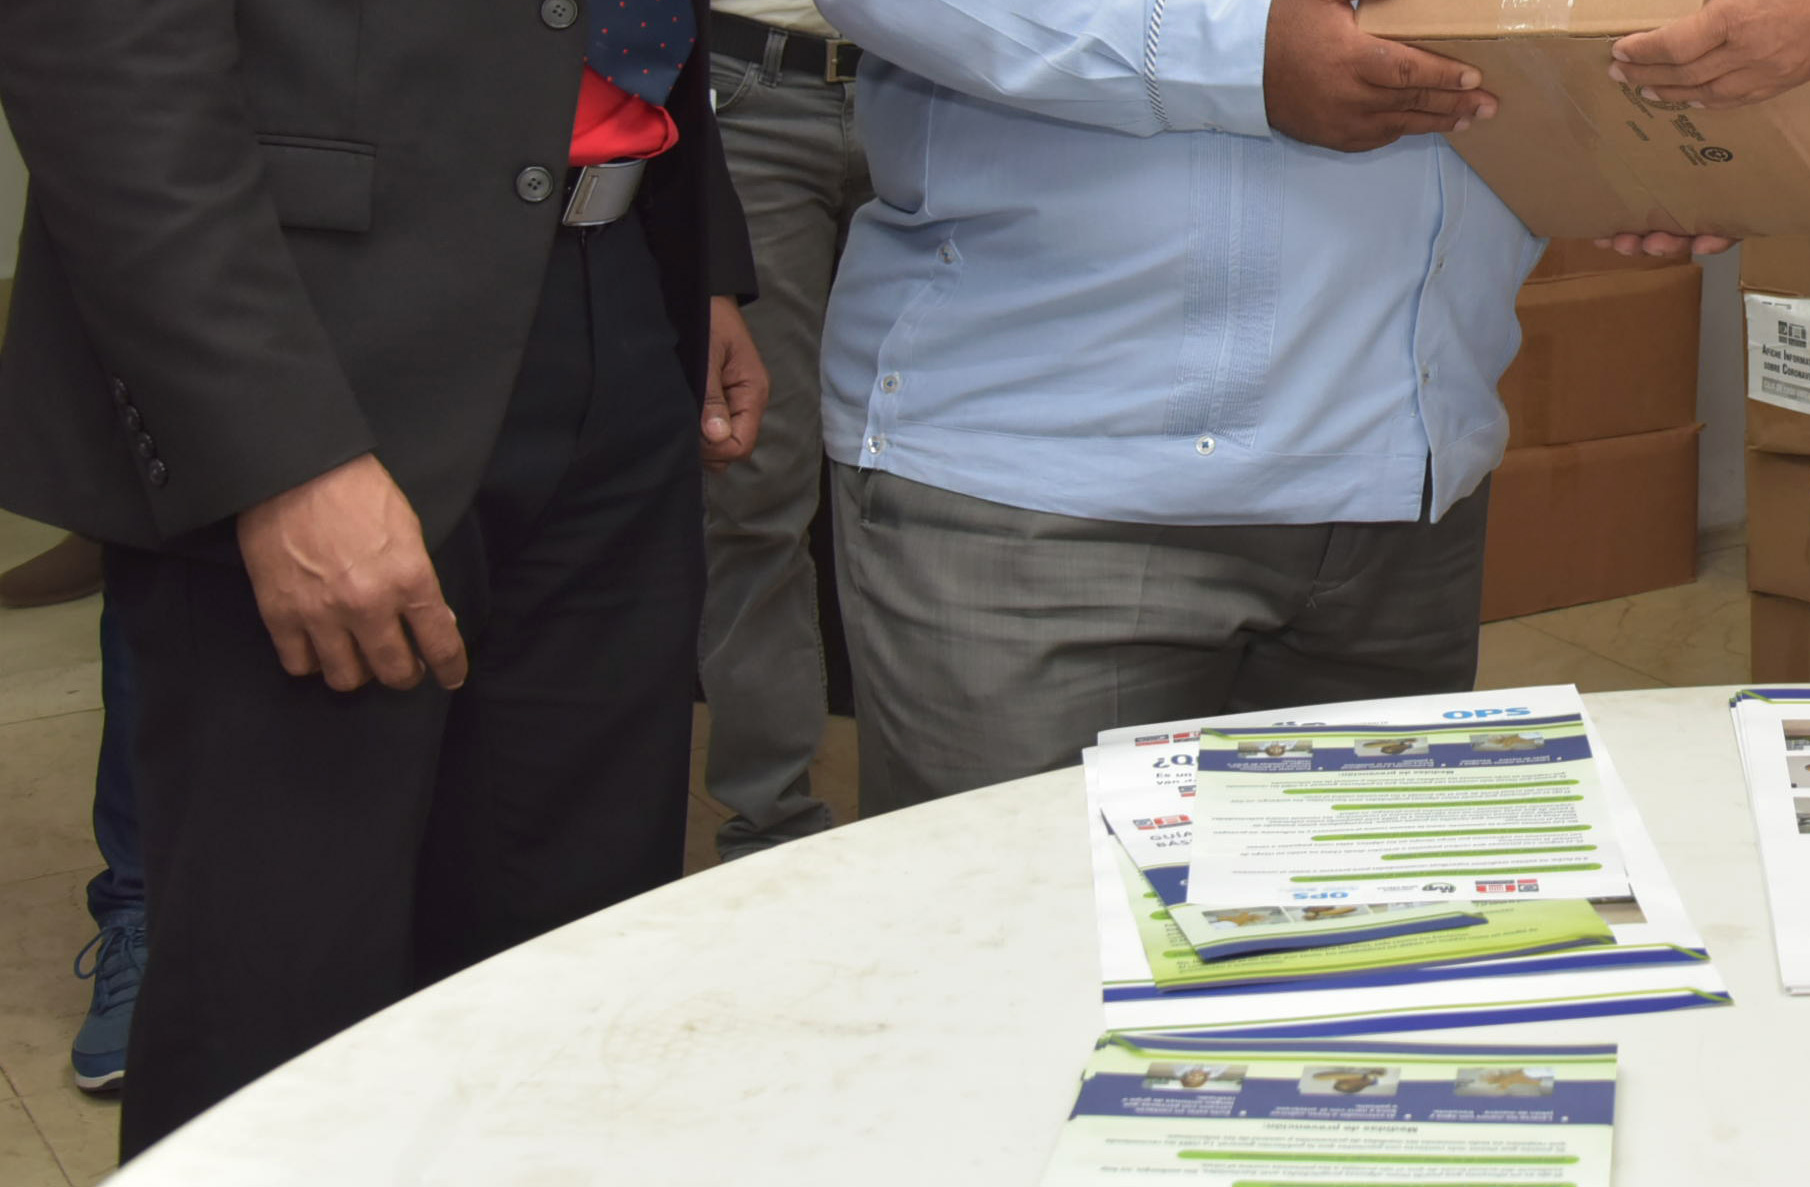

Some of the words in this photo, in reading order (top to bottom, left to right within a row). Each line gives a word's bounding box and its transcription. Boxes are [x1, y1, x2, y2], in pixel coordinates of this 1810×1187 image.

[1442, 706, 1531, 720] OPS
[1152, 754, 1195, 769] ¿Q
[1292, 891, 1349, 900] OPS
